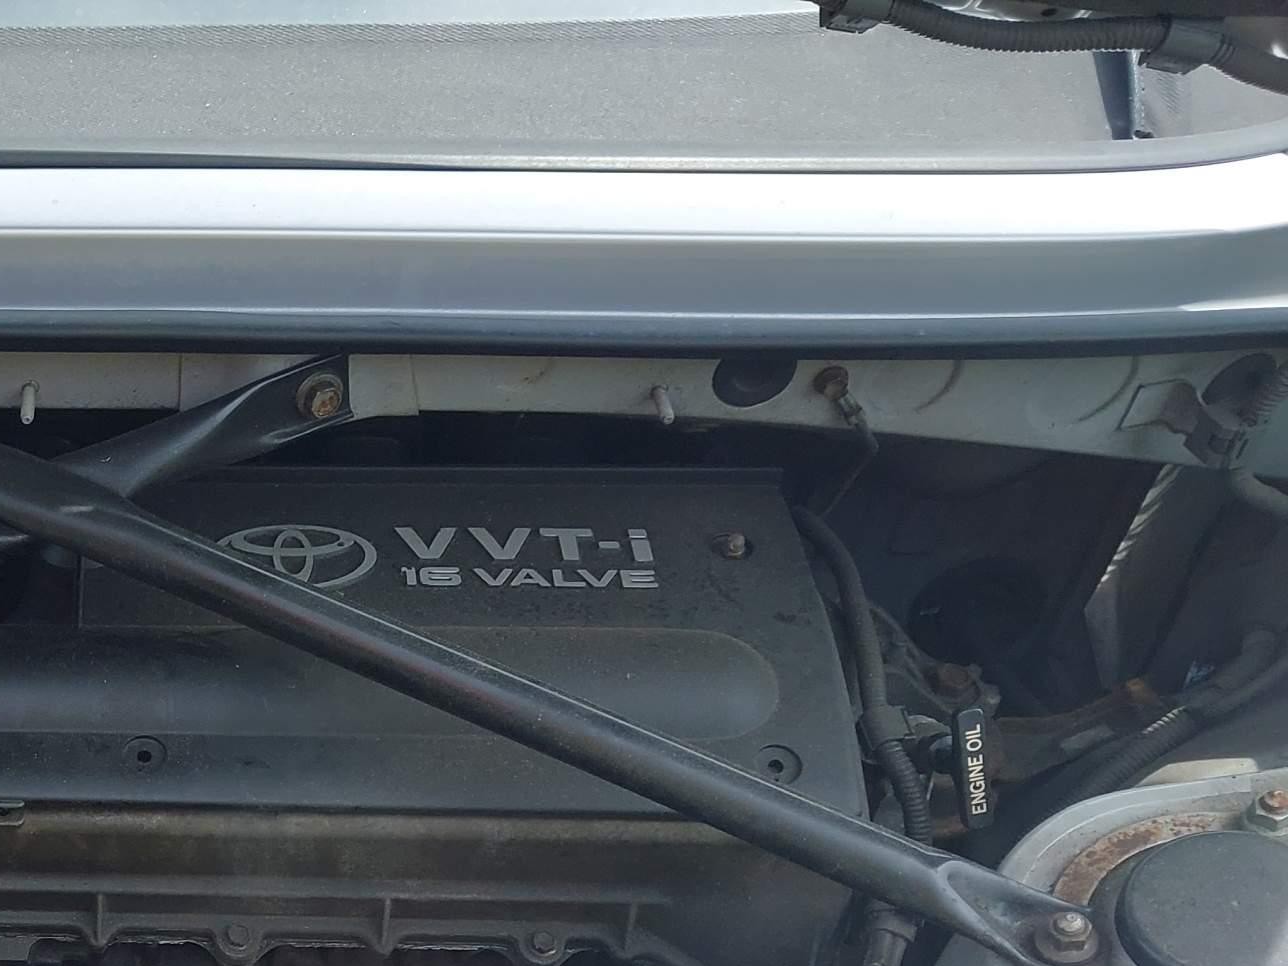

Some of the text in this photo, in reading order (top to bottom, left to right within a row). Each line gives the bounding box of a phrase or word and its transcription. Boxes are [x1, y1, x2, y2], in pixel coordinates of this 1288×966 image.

[394, 527, 654, 562] VVT-i
[401, 566, 659, 588] 16 VALVE
[965, 723, 987, 815] ENGINE OIL
